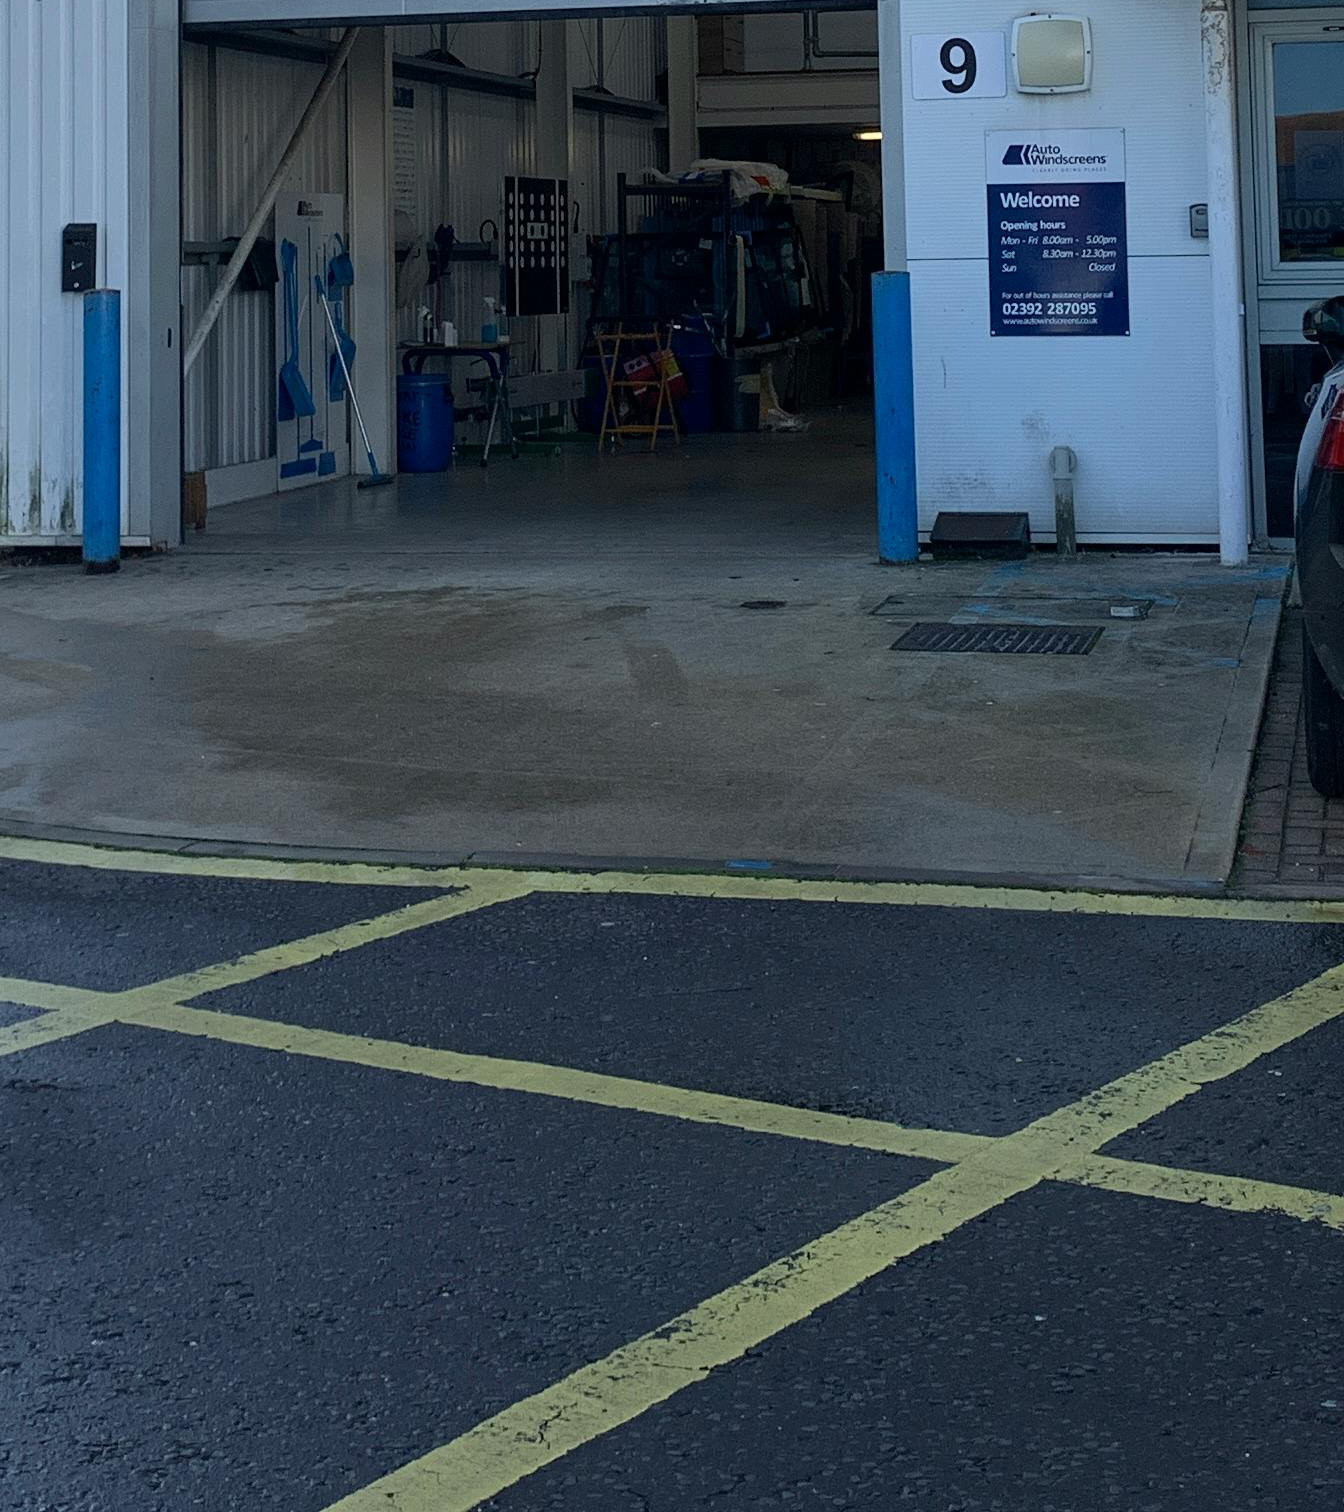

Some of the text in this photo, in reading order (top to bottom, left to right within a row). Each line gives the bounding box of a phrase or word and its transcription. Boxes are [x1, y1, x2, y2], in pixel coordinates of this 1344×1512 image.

[939, 37, 977, 94] 9
[1031, 144, 1060, 155] Auto
[1031, 154, 1106, 165] Windscreens
[1000, 191, 1080, 208] Welcome
[1000, 219, 1066, 231] Opening hours
[1001, 236, 1020, 245] Mon
[1028, 236, 1038, 245] Fri
[1042, 235, 1073, 245] 8.00am
[1086, 235, 1117, 245] 5.00pm
[1001, 250, 1016, 259] Sat
[1042, 249, 1073, 258] 8.30am
[1081, 248, 1116, 259] 12.30pm
[1002, 262, 1116, 272] Sun Closed
[1002, 302, 1096, 315] 02392 287095
